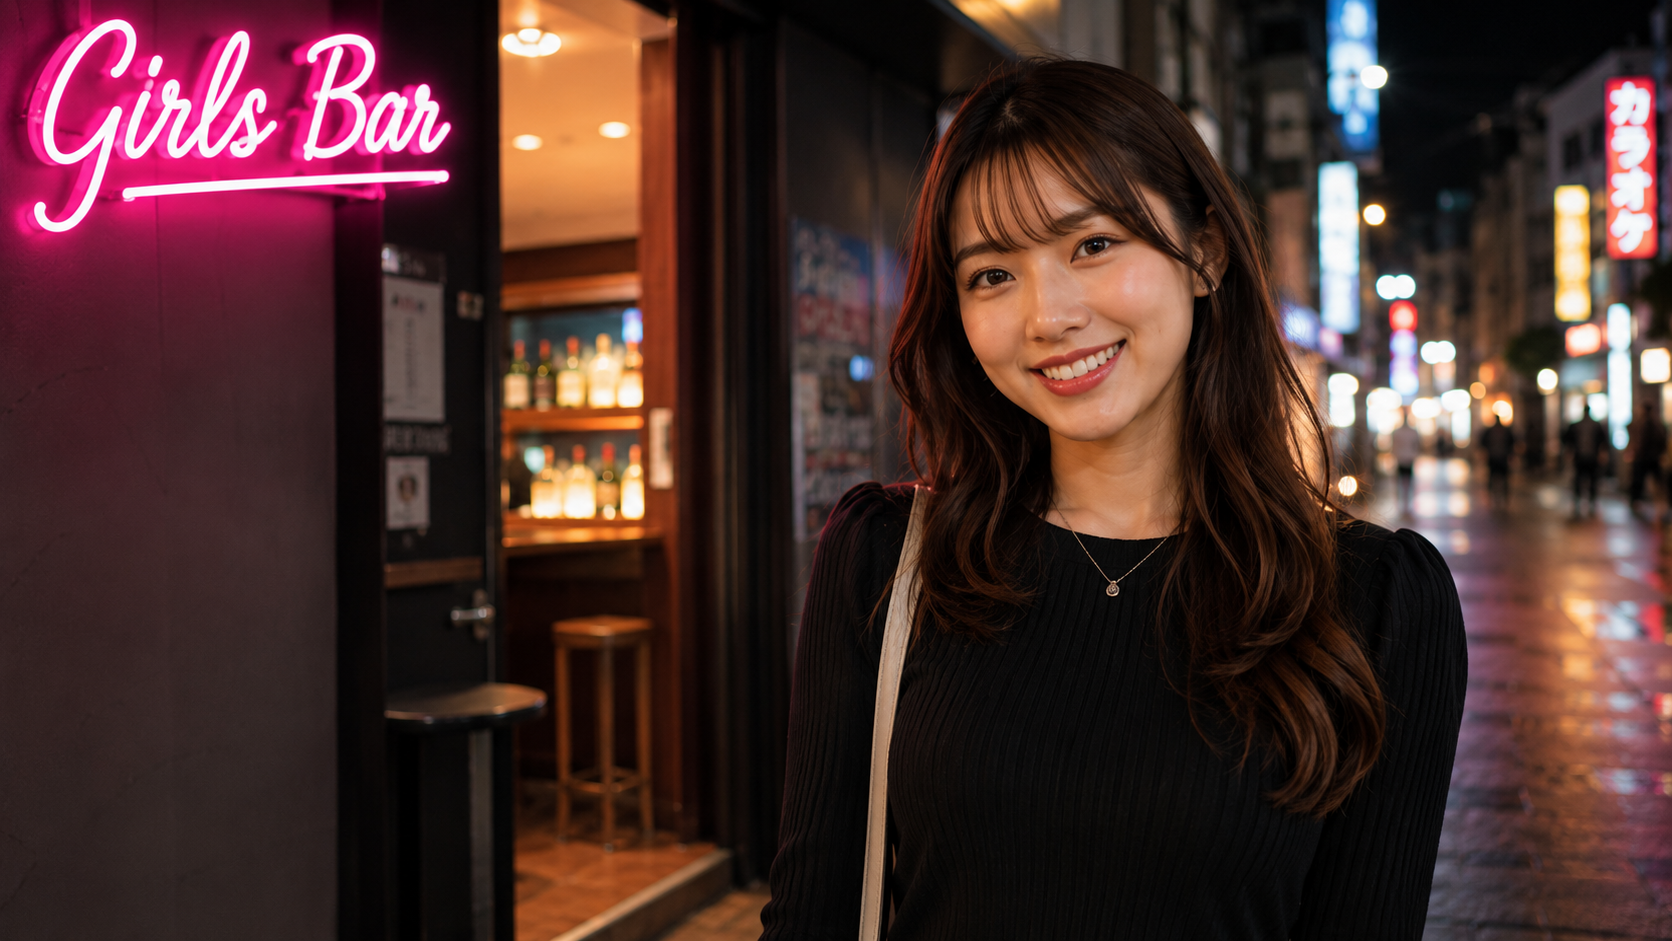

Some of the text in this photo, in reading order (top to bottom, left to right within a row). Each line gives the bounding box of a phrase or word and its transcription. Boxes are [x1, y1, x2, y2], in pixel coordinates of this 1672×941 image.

[34, 19, 451, 232] Girls Bar
[1610, 81, 1653, 254] カラオケ
